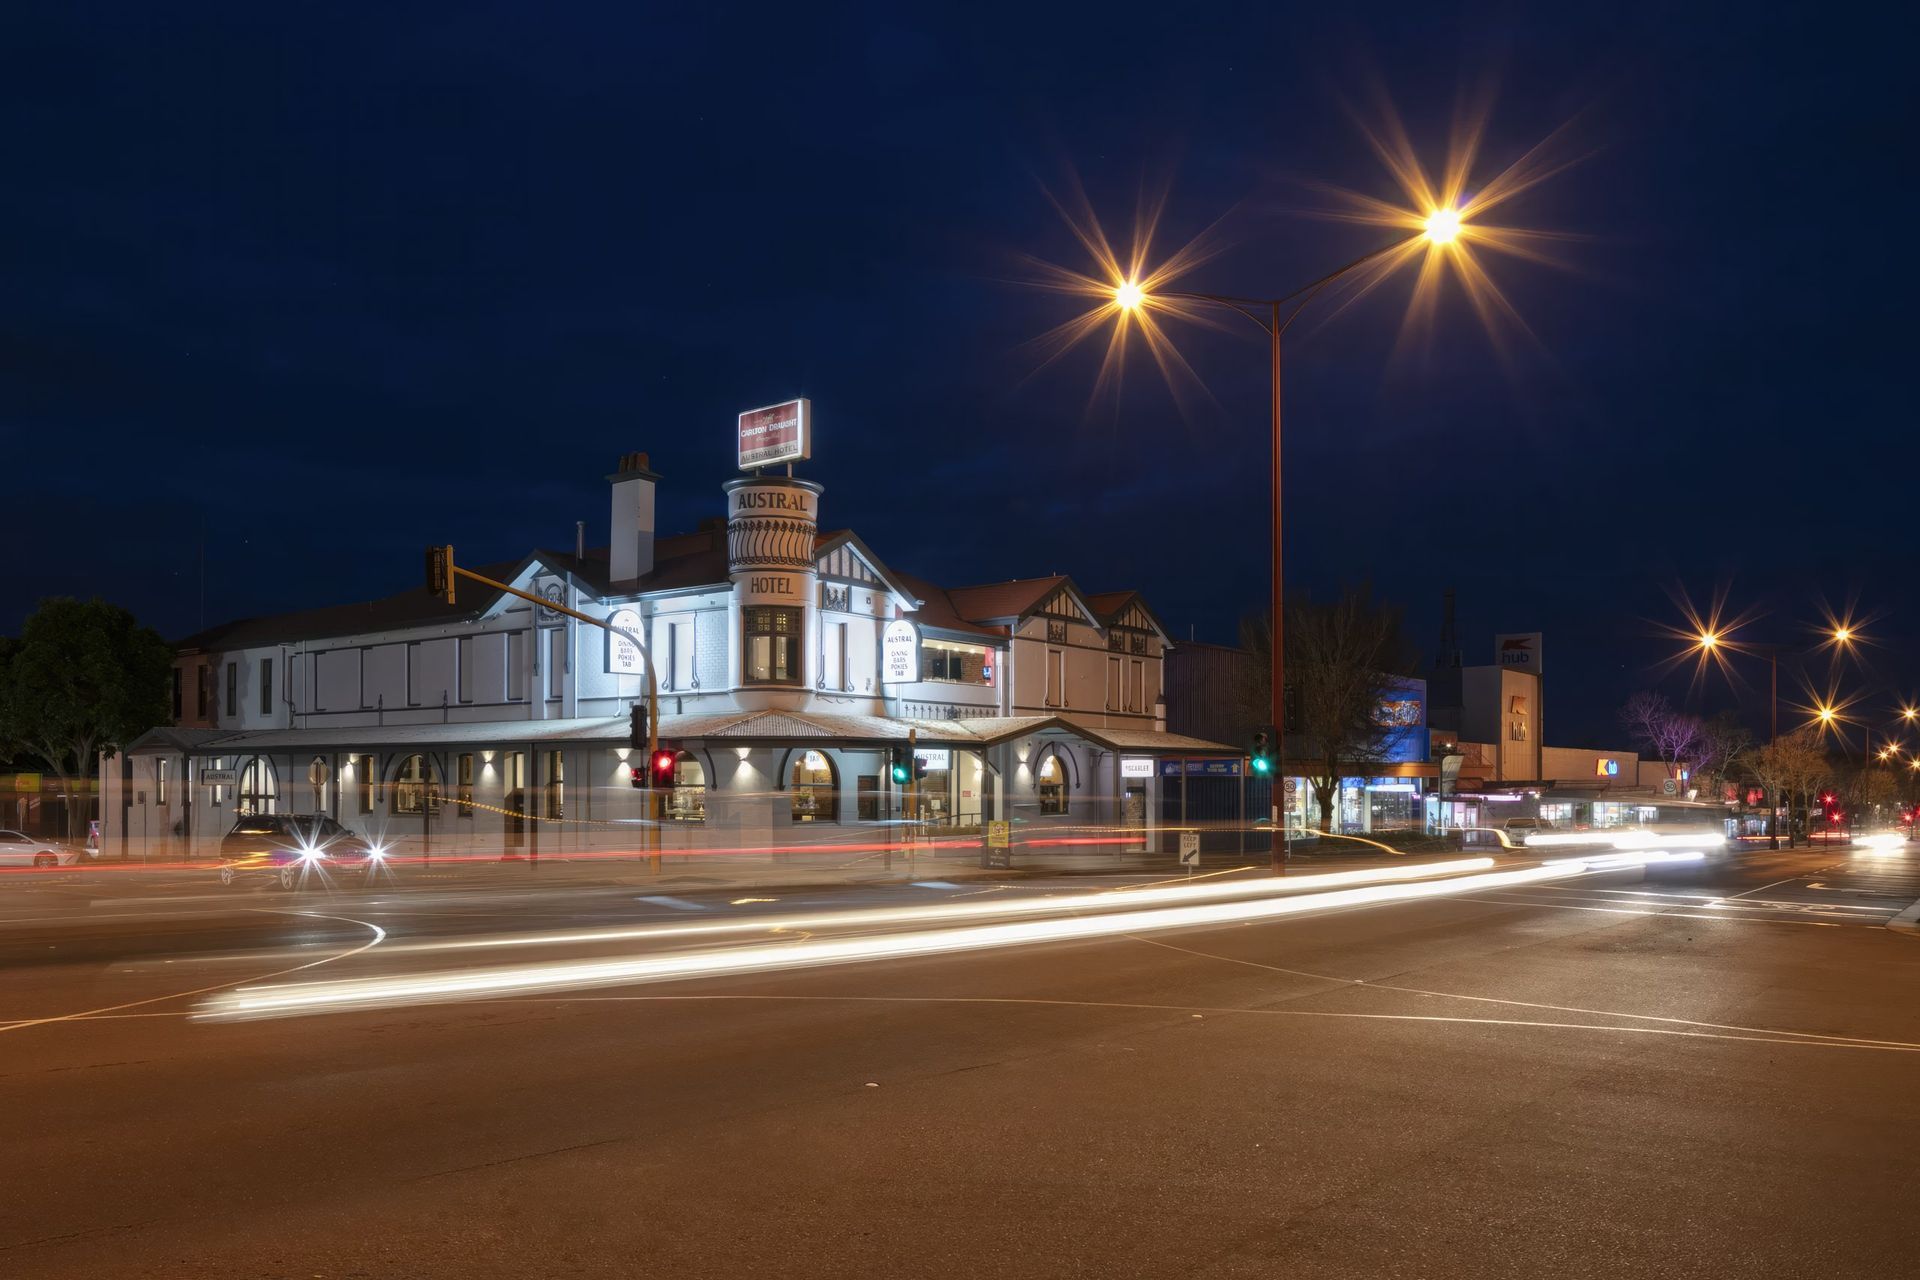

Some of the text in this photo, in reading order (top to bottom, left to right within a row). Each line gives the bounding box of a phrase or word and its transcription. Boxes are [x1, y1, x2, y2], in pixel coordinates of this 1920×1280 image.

[741, 425, 767, 437] CARLTON
[769, 418, 797, 431] DRAUGHT
[742, 444, 798, 462] AUSTRAL HOTEL
[738, 492, 808, 511] AUSTRAL
[751, 577, 794, 595] HOTEL
[888, 635, 912, 643] AUSTRAL
[1502, 649, 1529, 664] hub
